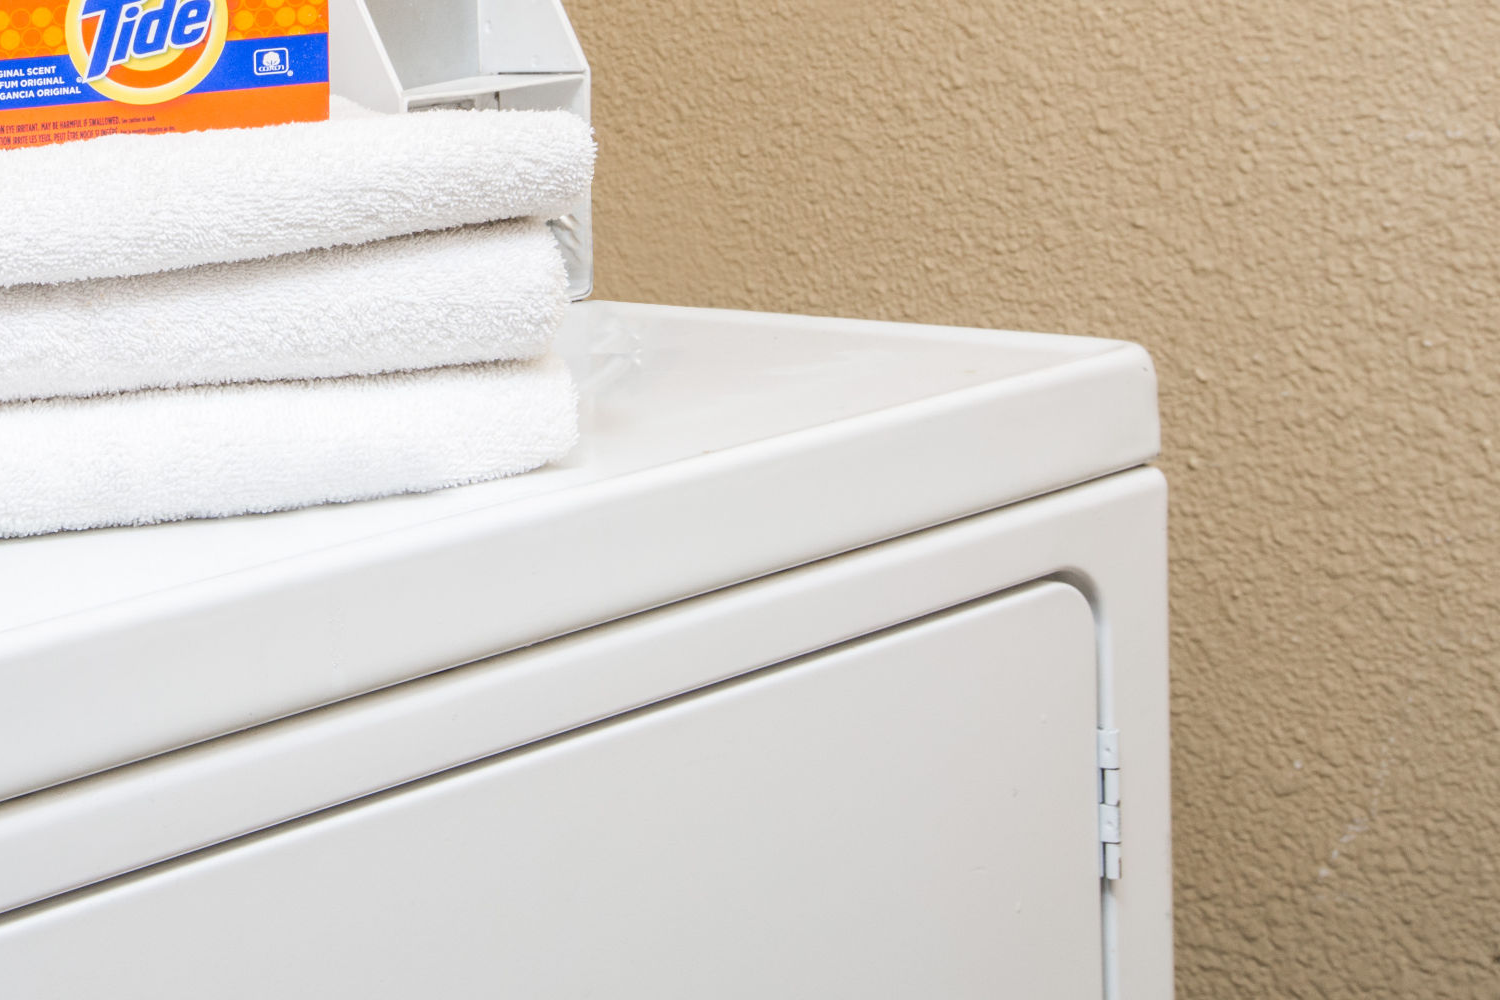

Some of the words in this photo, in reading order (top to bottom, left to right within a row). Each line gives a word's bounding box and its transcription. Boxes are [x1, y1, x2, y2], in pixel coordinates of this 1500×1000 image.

[26, 65, 57, 76] SCENT
[19, 76, 65, 88] ORIGINAL
[36, 86, 82, 98] ORIGINAL
